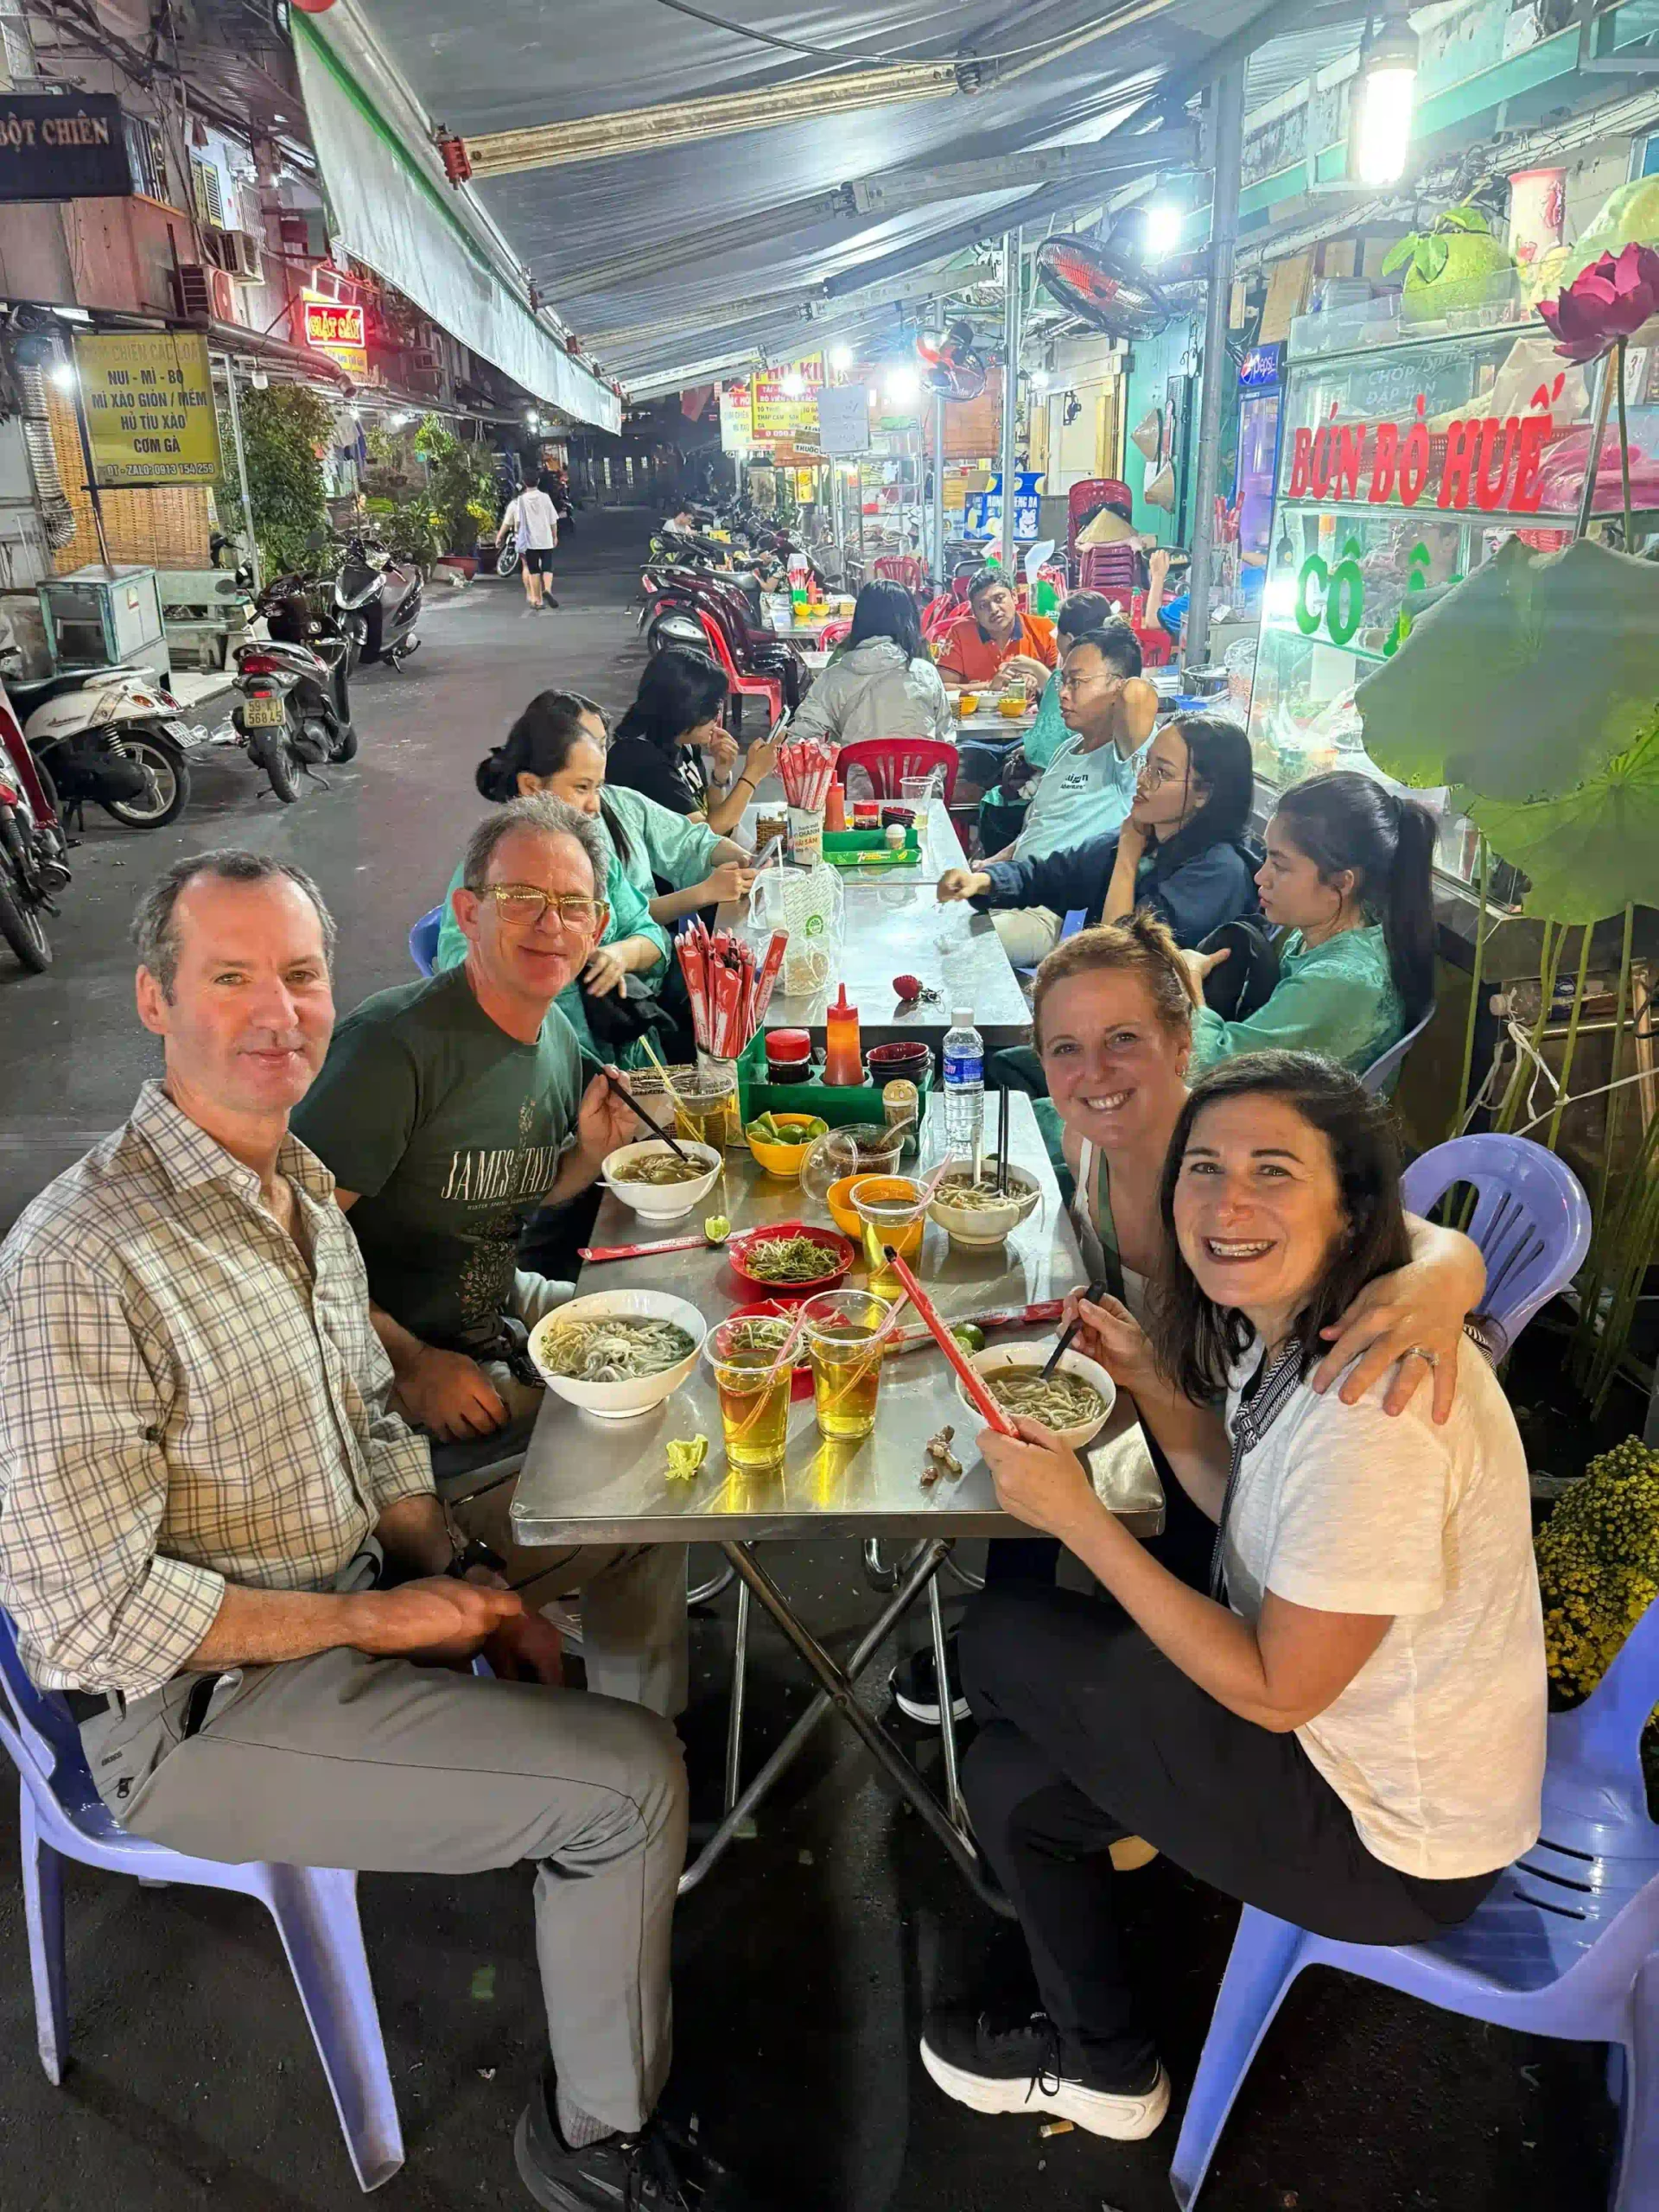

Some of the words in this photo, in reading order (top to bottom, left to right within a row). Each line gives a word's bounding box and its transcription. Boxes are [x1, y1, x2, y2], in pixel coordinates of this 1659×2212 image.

[41, 109, 110, 146] CHIÊN
[108, 370, 130, 385] NUI
[140, 366, 156, 385] MÌ
[92, 391, 107, 409] MÌ
[111, 391, 135, 408] XÀO
[120, 410, 137, 430] HỦ
[162, 411, 186, 429] XÀO
[134, 437, 162, 453] CƠM
[163, 435, 181, 453] GÀ
[1288, 401, 1367, 501] BÚN
[1368, 393, 1430, 507] BÒ
[1437, 372, 1567, 513] HUẾ
[154, 464, 177, 475] 0913
[179, 463, 197, 474] 154
[198, 463, 214, 474] 259
[1295, 536, 1364, 645] CÔ
[441, 1148, 515, 1201] JAMES
[518, 1145, 555, 1194] TAYL
